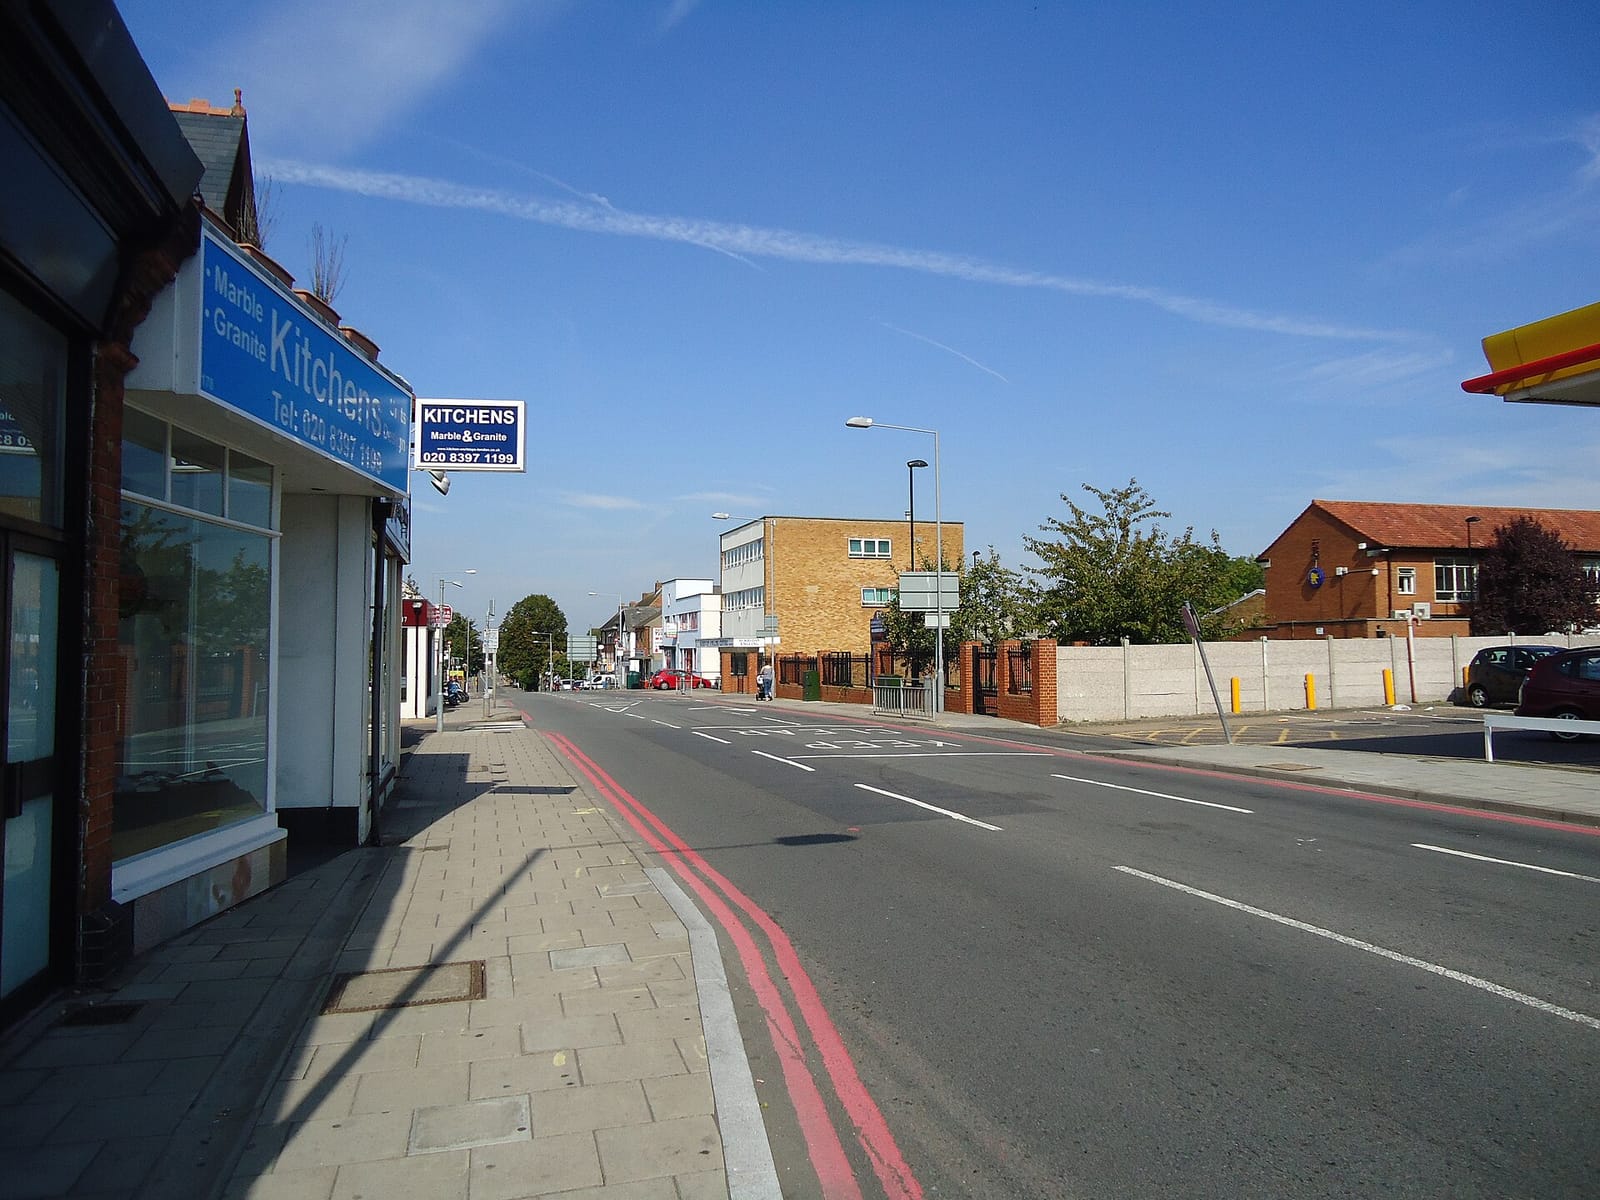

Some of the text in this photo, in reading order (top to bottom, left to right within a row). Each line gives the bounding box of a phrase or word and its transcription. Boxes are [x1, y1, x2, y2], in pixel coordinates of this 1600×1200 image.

[214, 264, 264, 323] Marble
[213, 307, 267, 362] Granite
[270, 307, 382, 438] Kitchens
[424, 407, 515, 425] KITCHENS
[302, 408, 326, 446] 020
[329, 424, 357, 461] 8397
[423, 452, 514, 464] 020 8397 1199
[729, 728, 902, 736] CLEAR
[805, 739, 963, 749] KEEP
